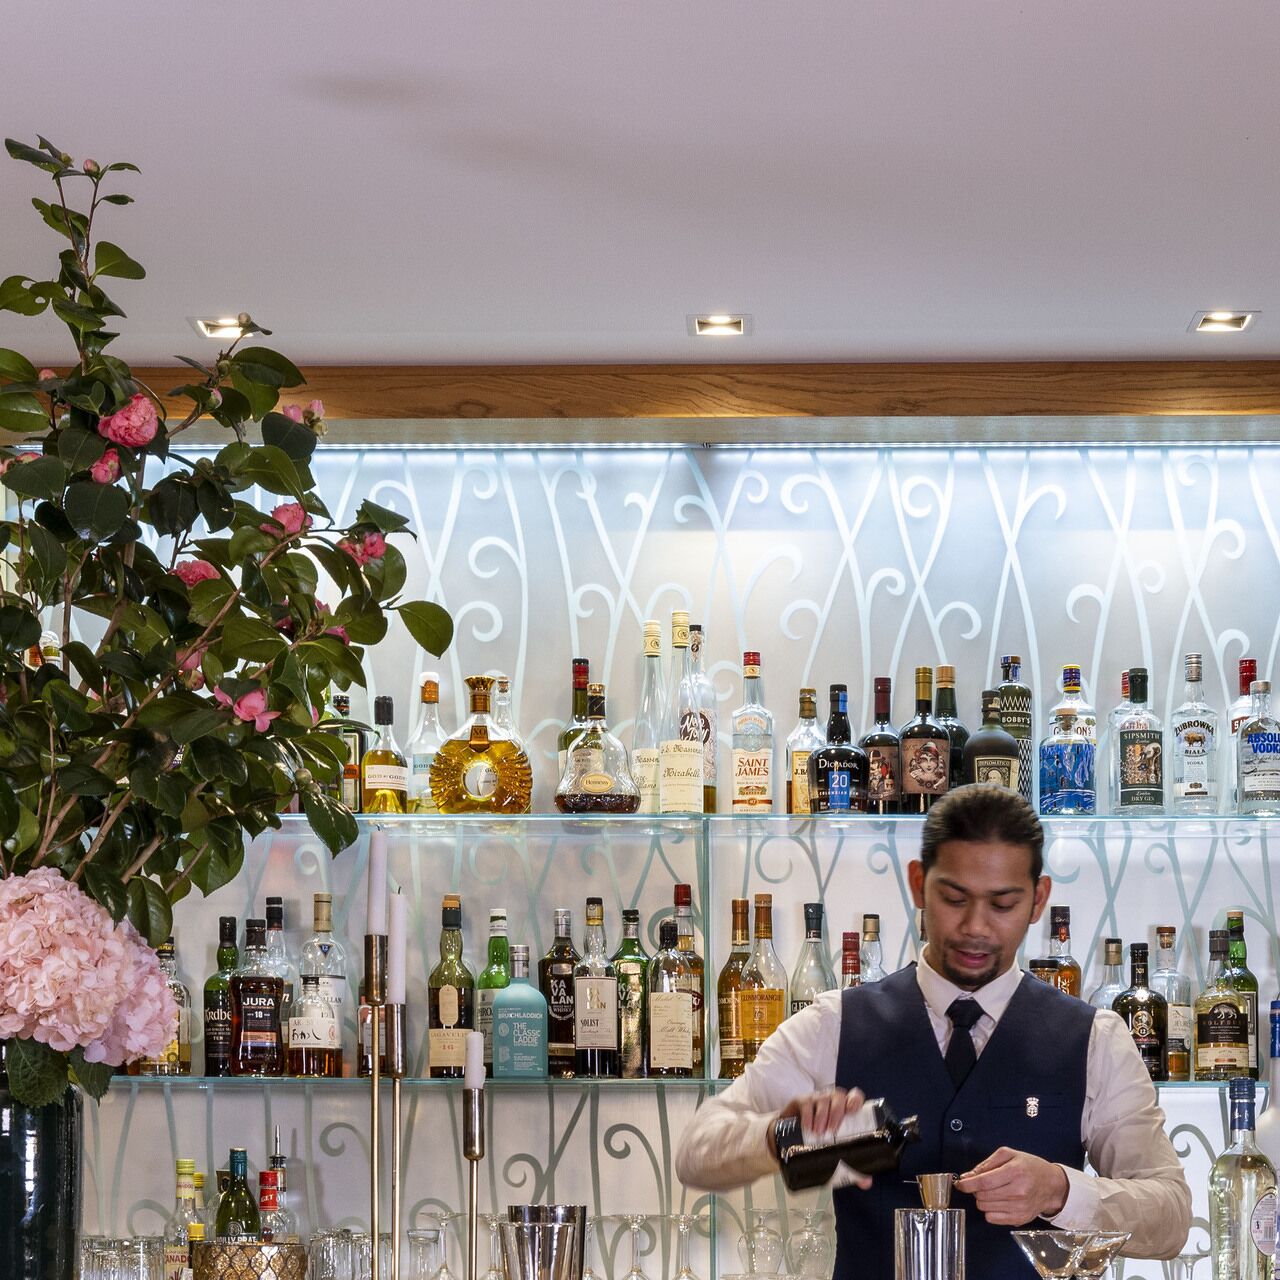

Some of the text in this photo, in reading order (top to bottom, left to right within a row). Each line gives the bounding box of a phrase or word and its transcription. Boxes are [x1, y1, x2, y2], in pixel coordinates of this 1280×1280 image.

[738, 757, 768, 768] SAINT
[735, 767, 769, 777] JAMES
[832, 775, 848, 788] 20
[242, 997, 275, 1006] JURA
[551, 996, 574, 1005] LAN
[205, 1008, 232, 1023] Ardbe
[513, 1022, 528, 1030] THE
[513, 1029, 541, 1037] CLASSIC
[513, 1036, 539, 1044] LADDIE
[260, 1194, 274, 1203] GET
